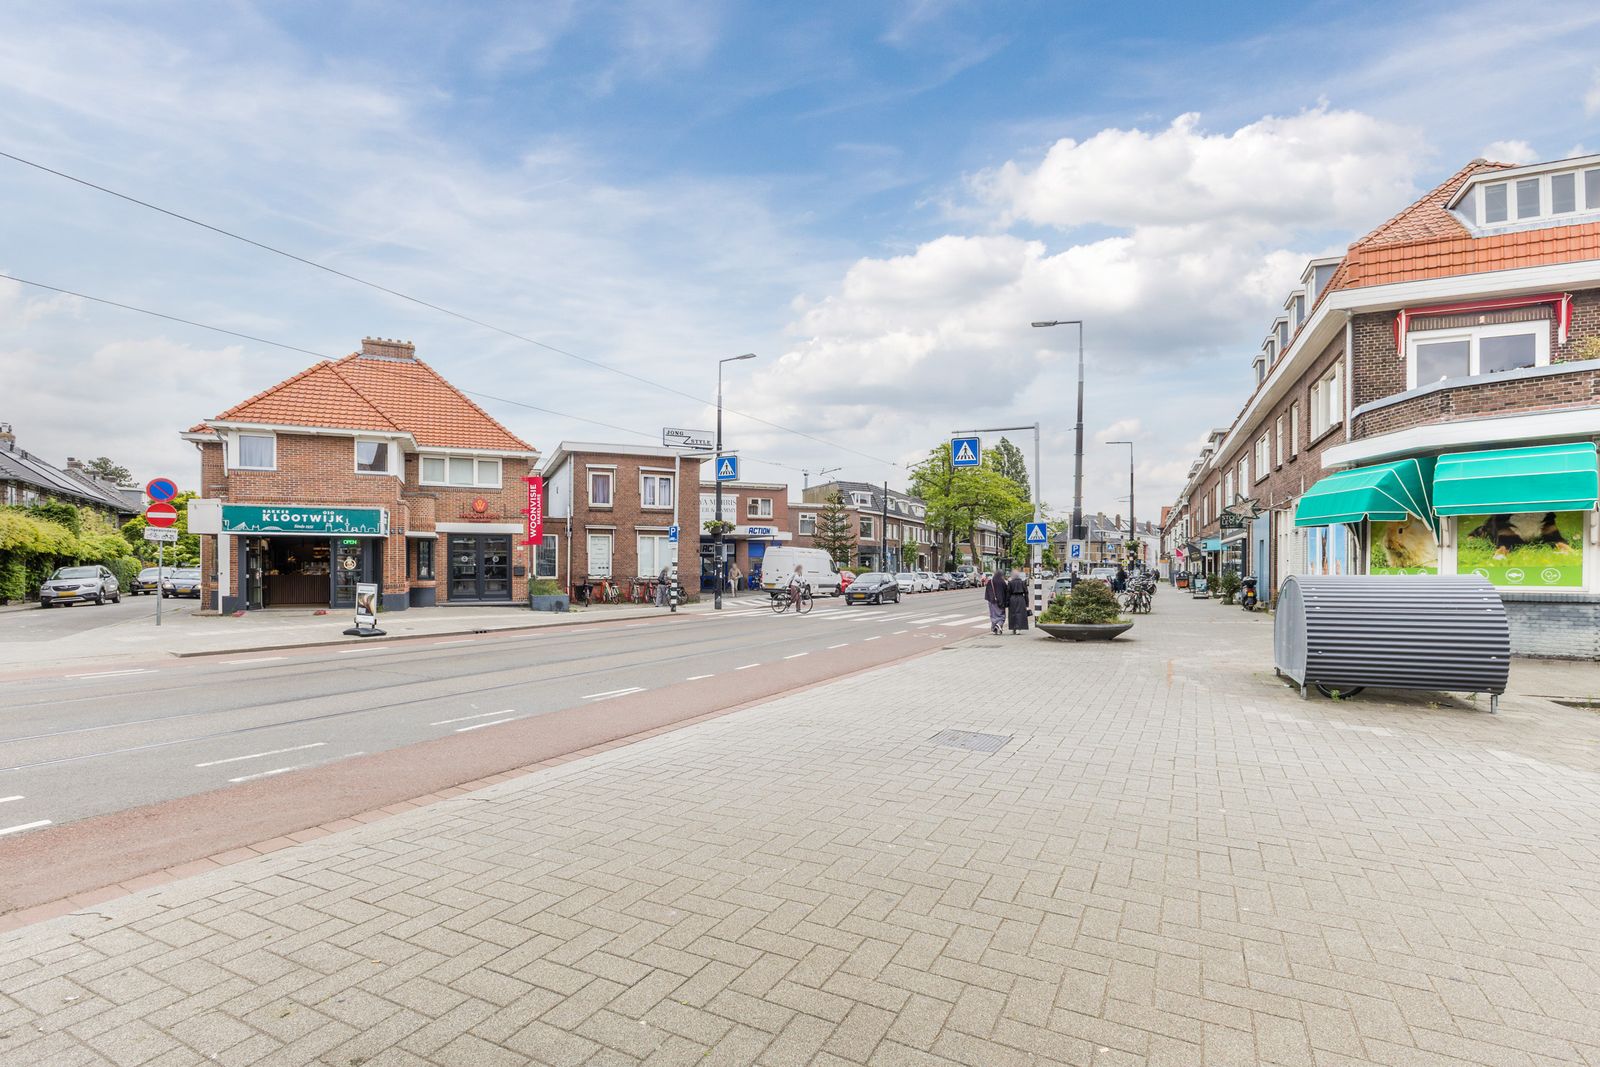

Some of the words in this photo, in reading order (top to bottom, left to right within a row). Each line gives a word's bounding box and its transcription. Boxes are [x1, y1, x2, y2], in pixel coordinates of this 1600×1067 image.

[262, 513, 344, 523] KLOOTWIJK
[670, 527, 676, 536] P
[748, 527, 771, 535] ACTION
[702, 544, 715, 553] AC
